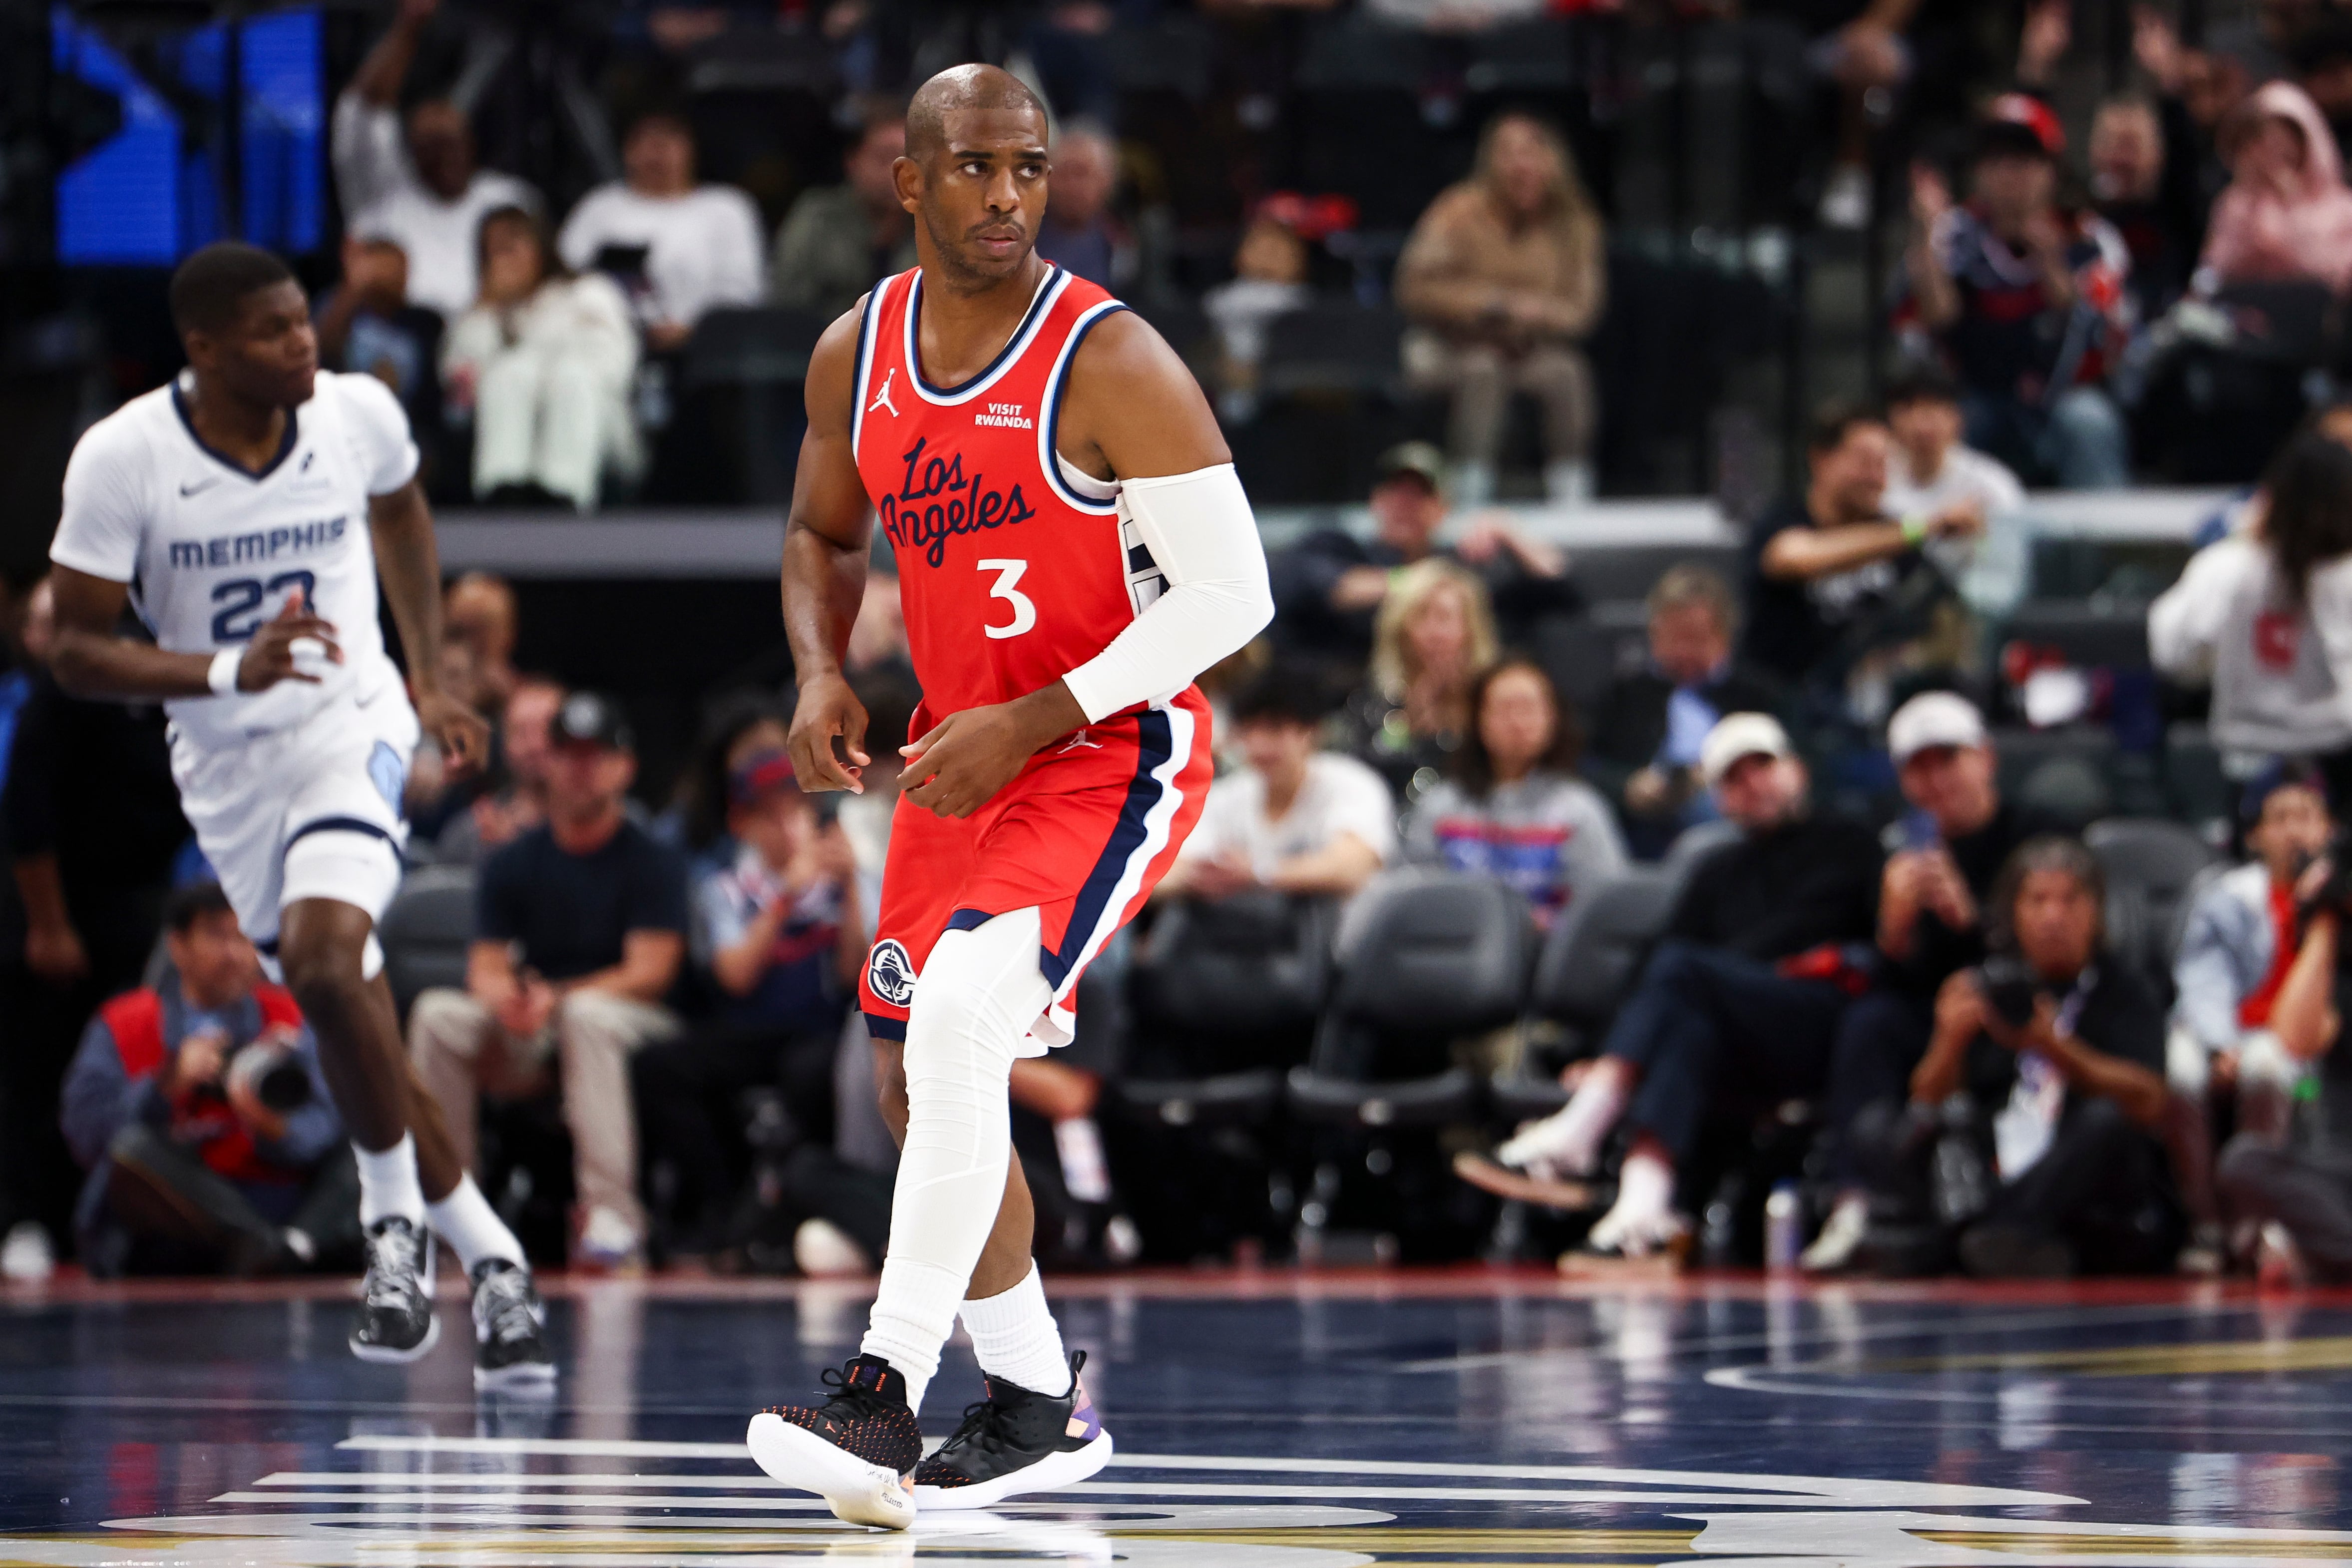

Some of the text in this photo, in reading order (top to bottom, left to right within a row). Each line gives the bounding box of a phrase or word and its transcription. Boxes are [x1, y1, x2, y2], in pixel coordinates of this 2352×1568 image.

[975, 414, 1032, 429] RWANDA
[988, 403, 1022, 415] VISIT
[899, 436, 968, 502] Los
[170, 516, 346, 569] MEMPHIS
[881, 474, 1036, 568] Angeles
[977, 559, 1037, 639] 3
